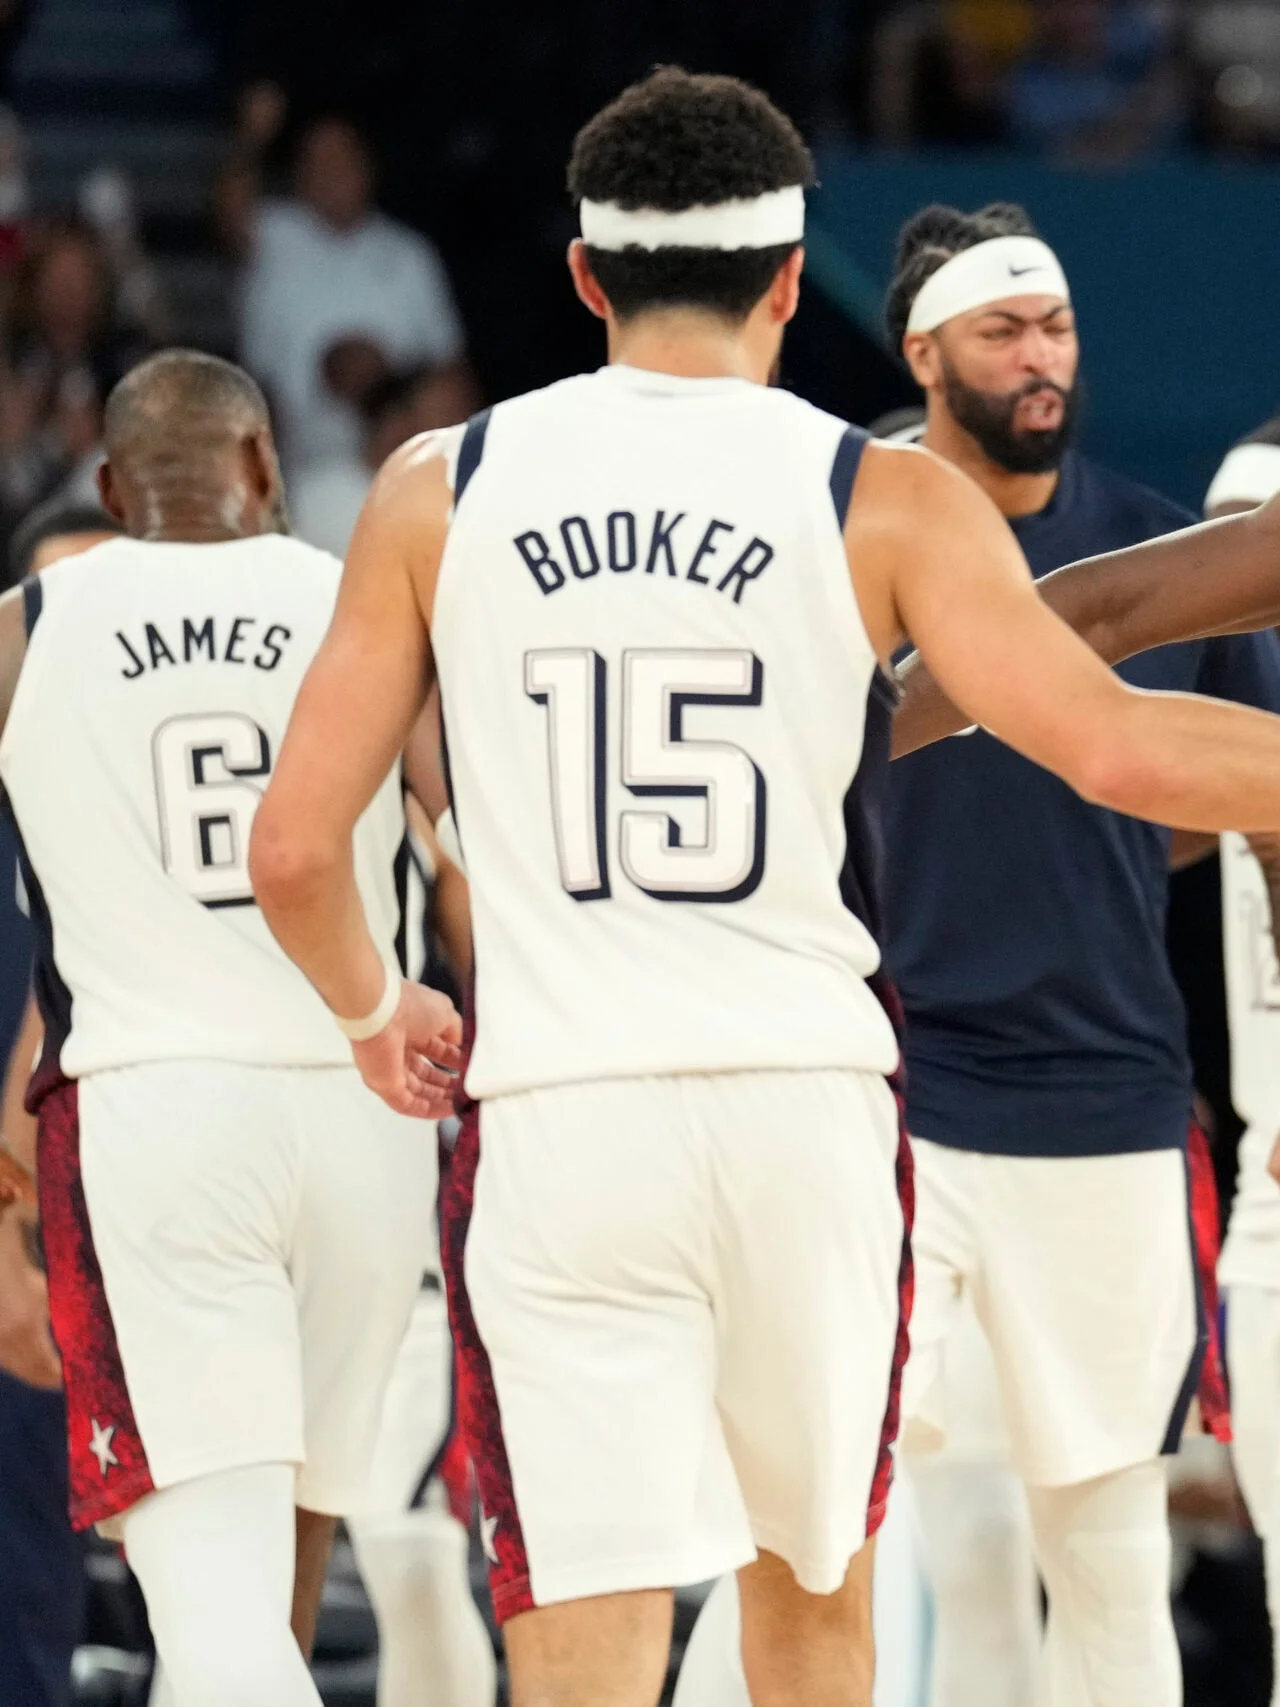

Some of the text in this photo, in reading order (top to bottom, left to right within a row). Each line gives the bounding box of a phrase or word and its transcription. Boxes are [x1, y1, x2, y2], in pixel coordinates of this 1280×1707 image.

[513, 510, 774, 605] BOOKER
[115, 616, 292, 680] JAMES
[151, 710, 271, 910] 6
[524, 646, 767, 904] 15
